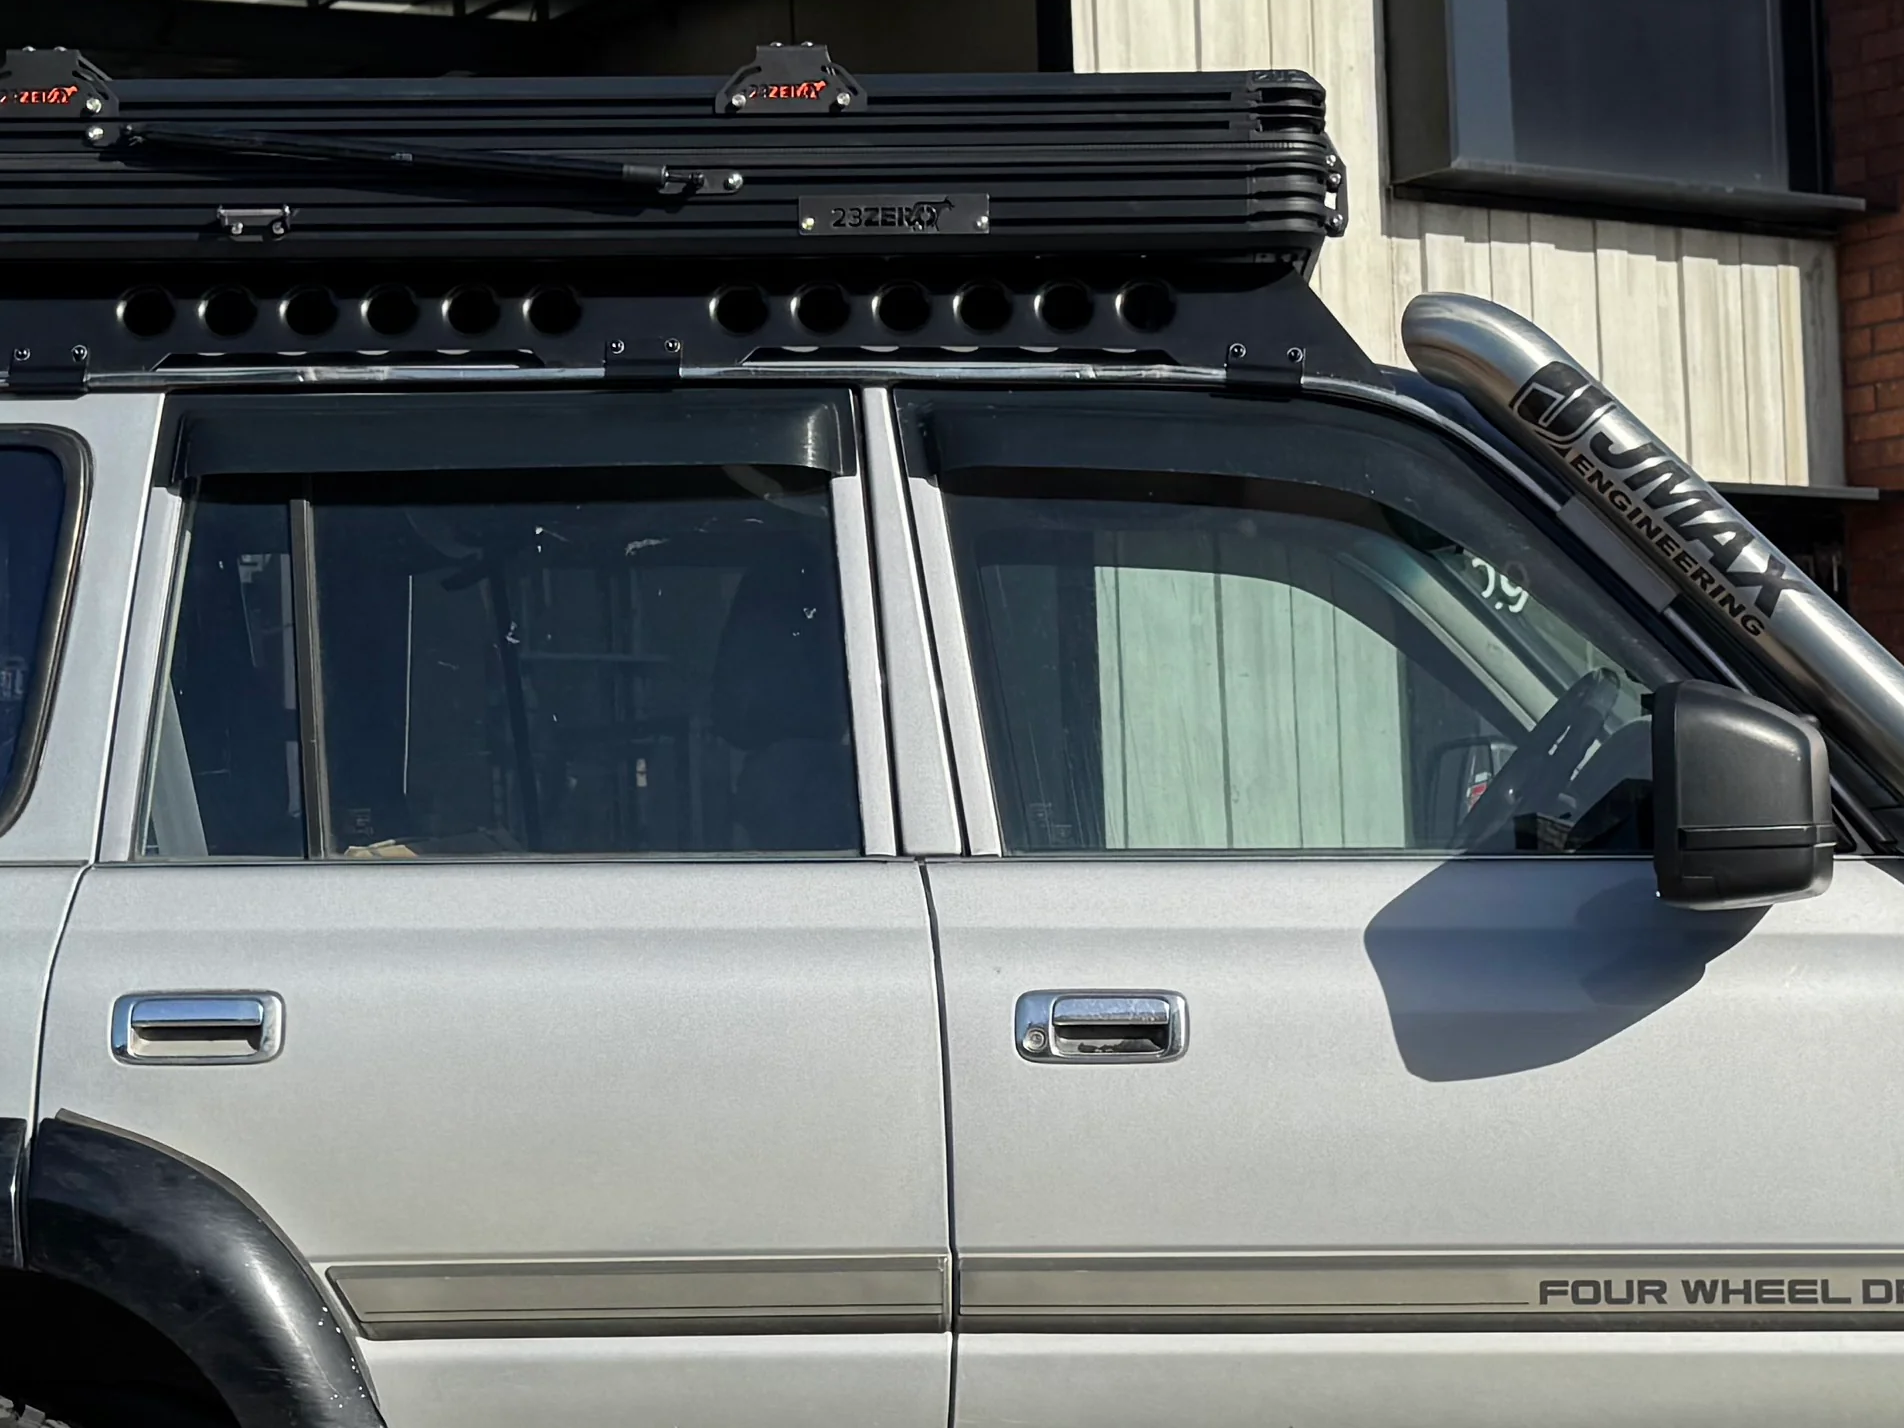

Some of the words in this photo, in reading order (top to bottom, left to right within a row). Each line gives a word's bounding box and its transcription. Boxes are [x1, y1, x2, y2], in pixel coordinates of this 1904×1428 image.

[831, 205, 938, 229] 23ZERO
[1569, 451, 1766, 638] ENGINEERING
[1588, 416, 1813, 620] JMAX
[1537, 1278, 1668, 1306] FOUR
[1680, 1278, 1853, 1306] WHEEL
